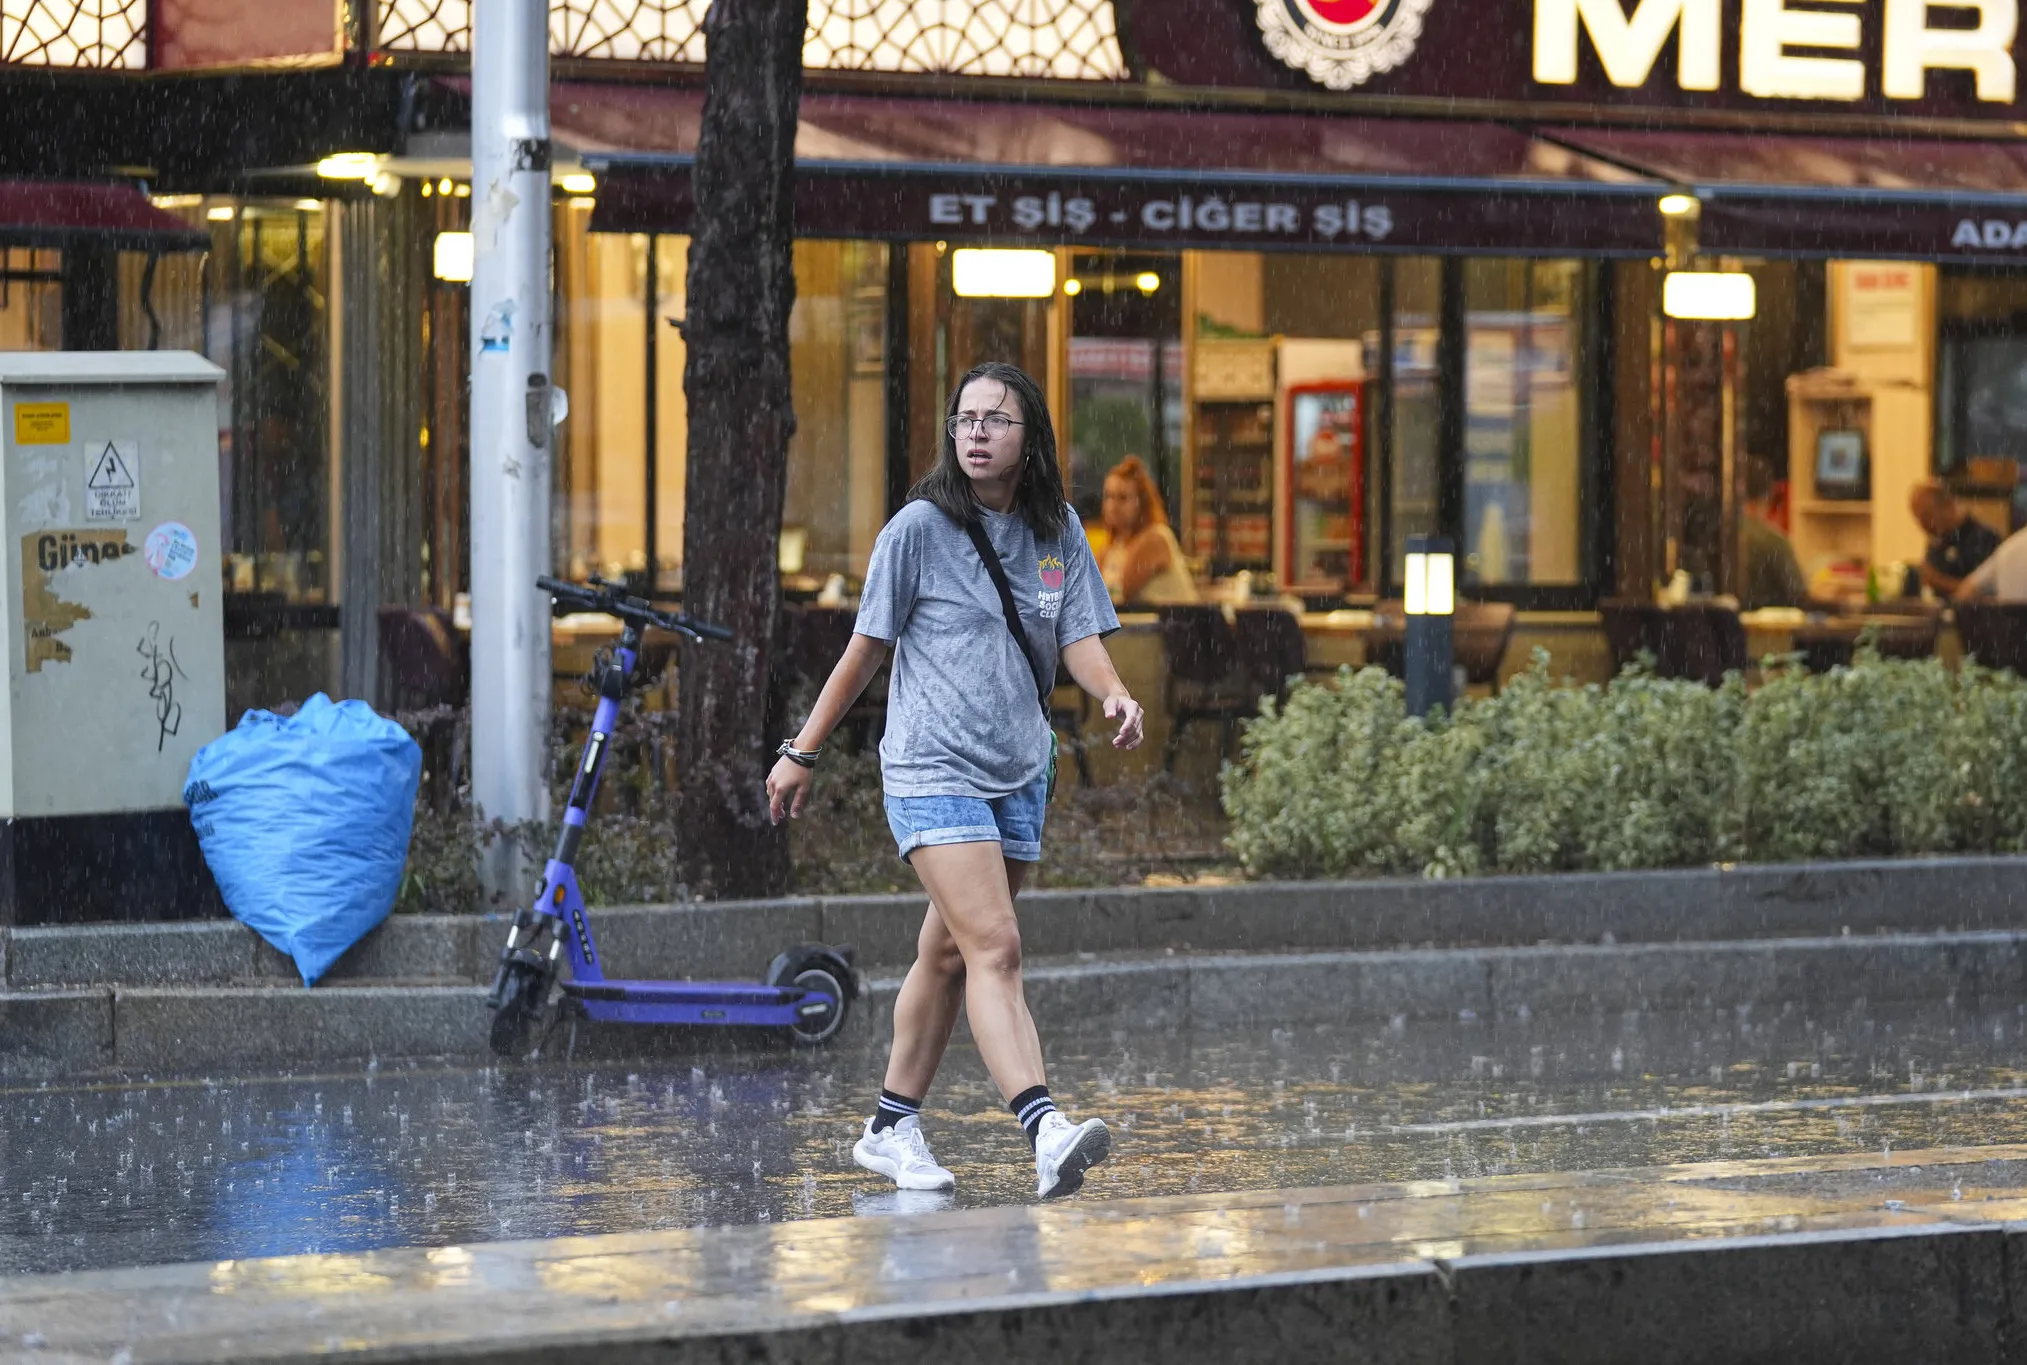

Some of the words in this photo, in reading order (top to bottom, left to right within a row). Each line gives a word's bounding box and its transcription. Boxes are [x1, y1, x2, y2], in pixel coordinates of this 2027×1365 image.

[1532, 0, 2017, 104] MER
[929, 193, 997, 224] ET
[1012, 192, 1095, 231] ŞİŞ
[1142, 195, 1298, 232] CİĞER
[1313, 201, 1393, 238] ŞİŞ
